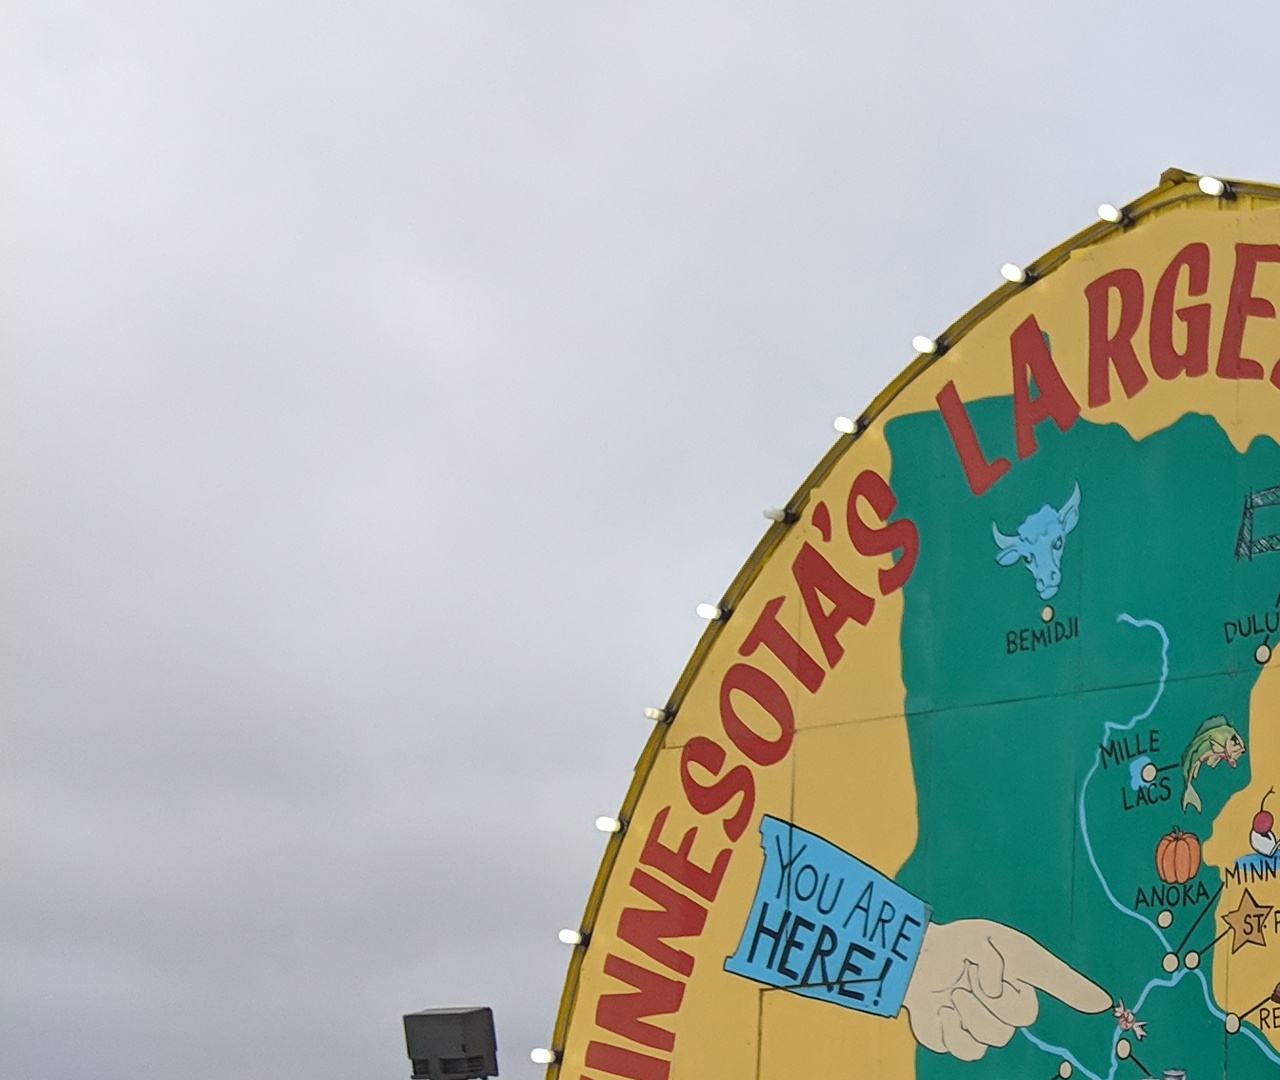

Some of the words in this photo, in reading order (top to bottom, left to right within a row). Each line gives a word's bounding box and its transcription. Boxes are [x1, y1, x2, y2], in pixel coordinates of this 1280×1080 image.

[1005, 617, 1080, 655] BEMIDJI
[1099, 729, 1161, 770] MILLE
[1122, 776, 1172, 811] LACS
[775, 834, 835, 917] YOU
[849, 879, 922, 963] ARE
[1134, 881, 1211, 911] ANOKA
[746, 901, 895, 1008] HERE!
